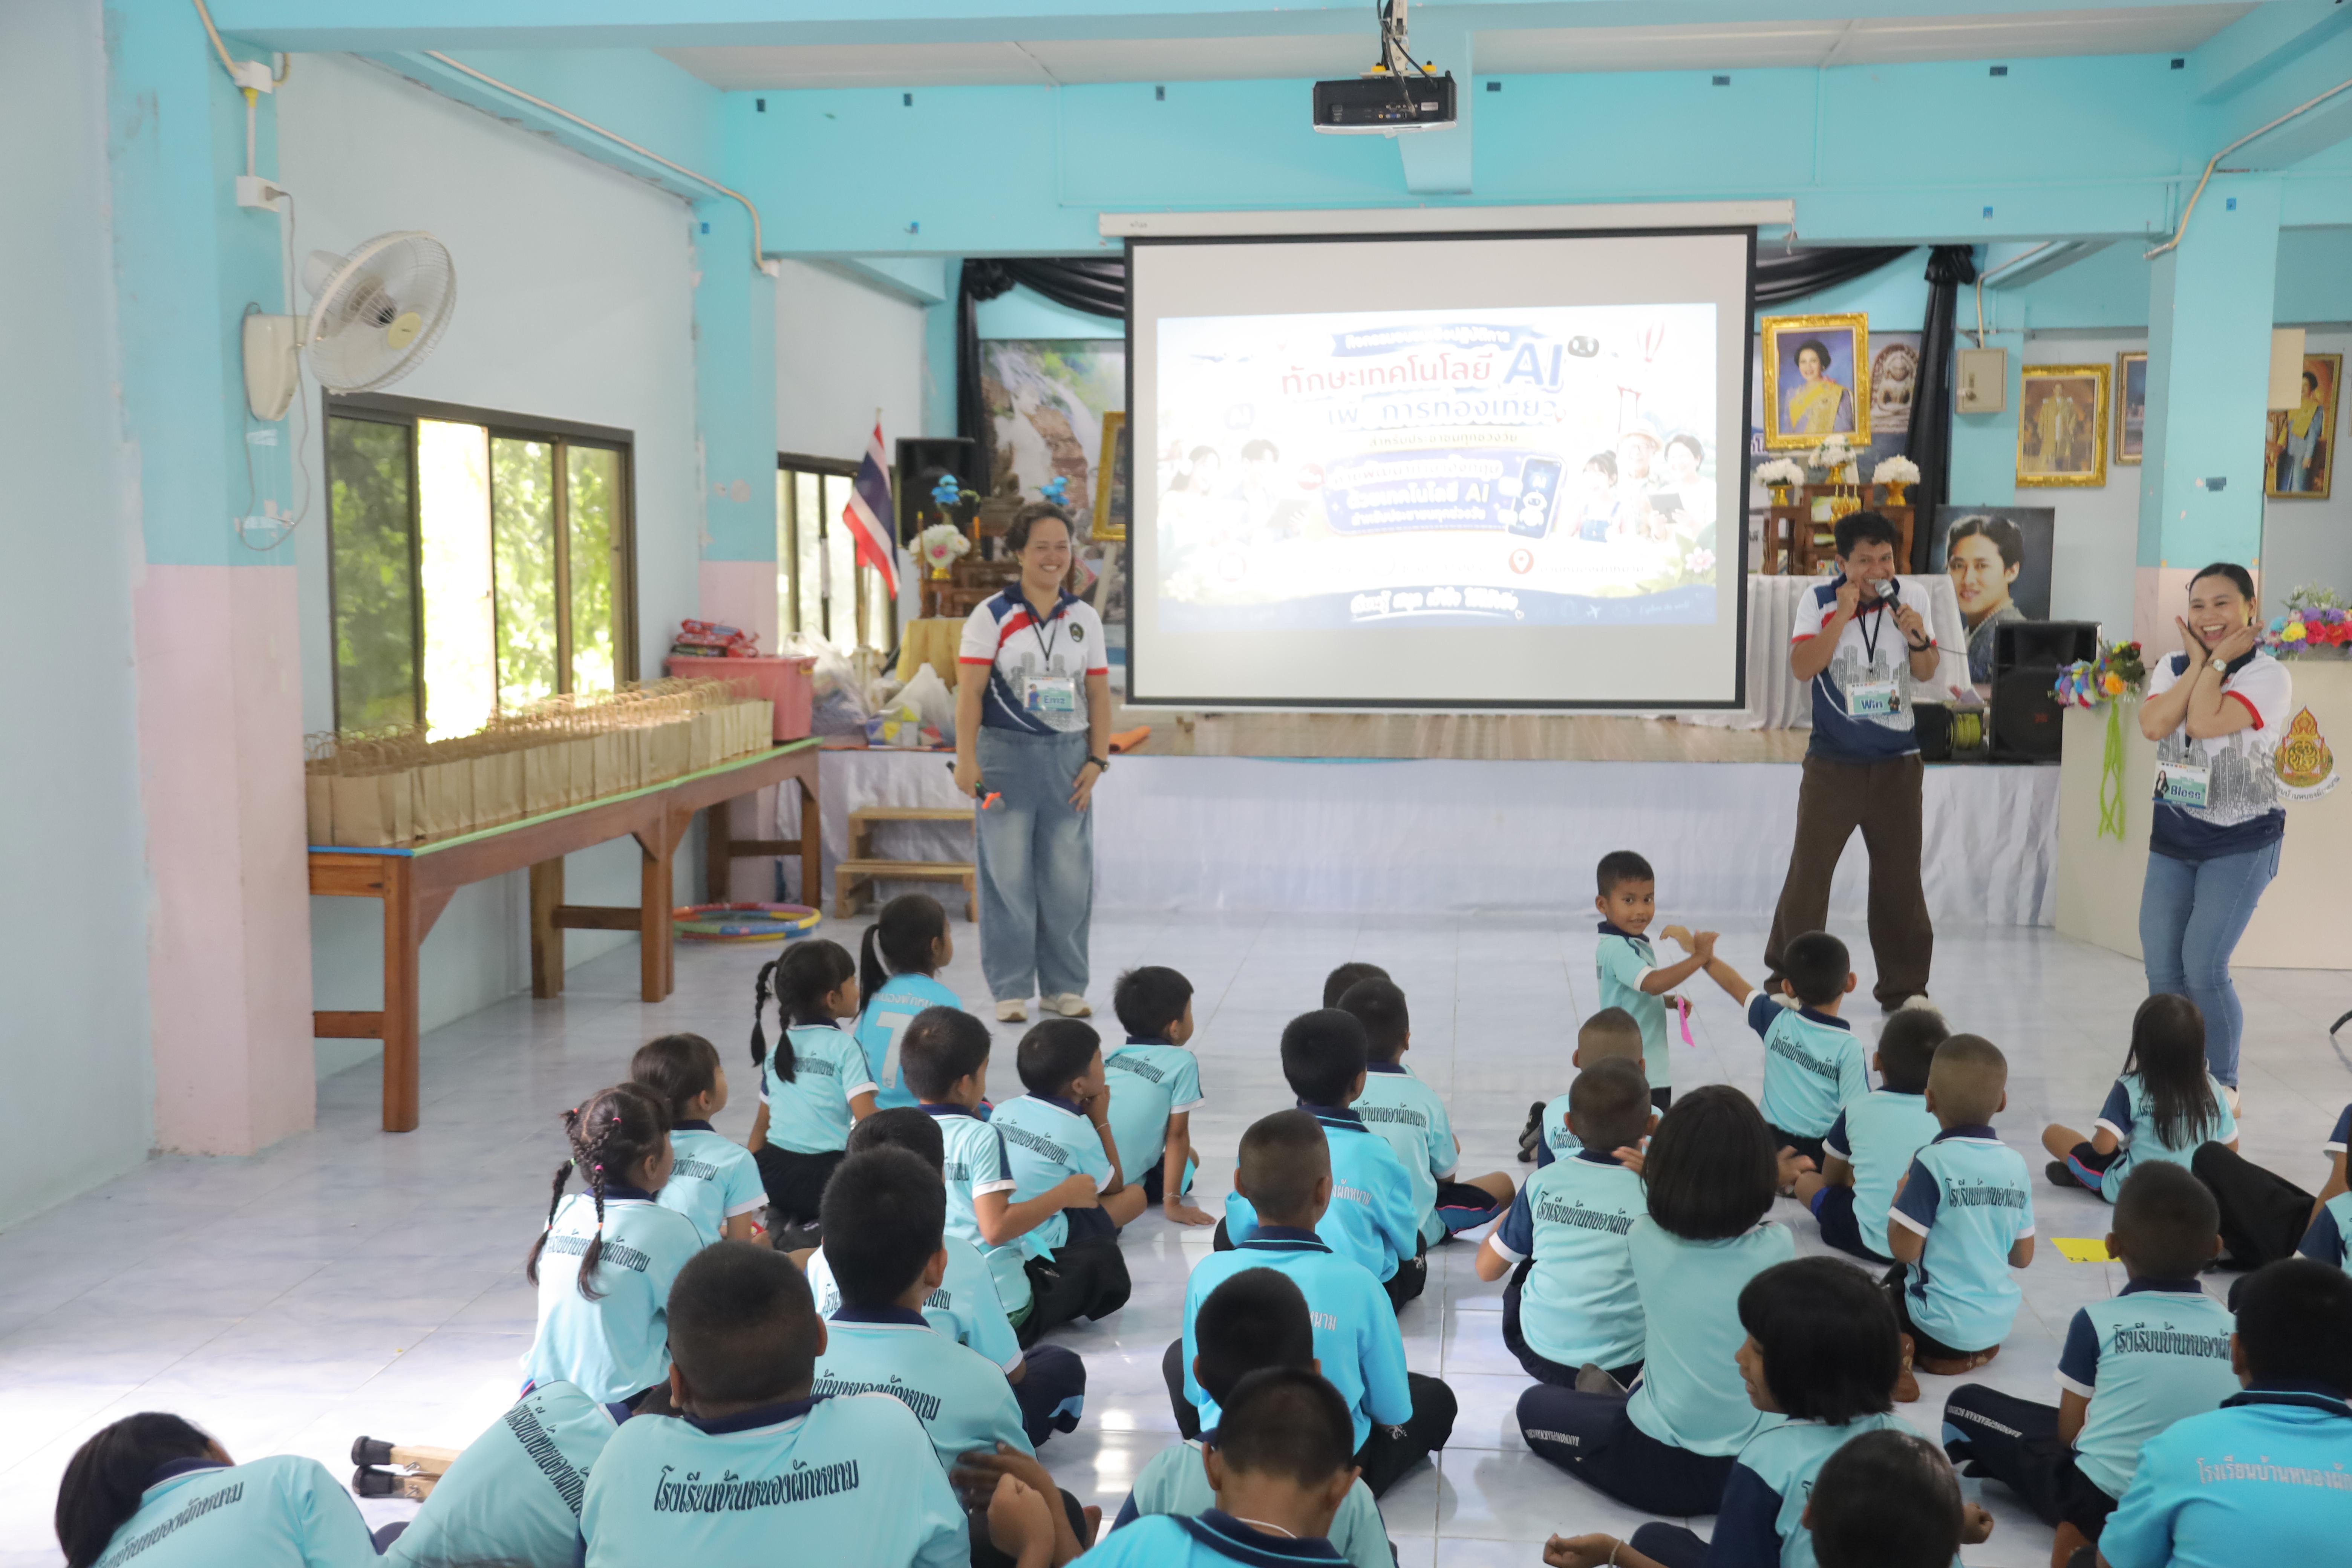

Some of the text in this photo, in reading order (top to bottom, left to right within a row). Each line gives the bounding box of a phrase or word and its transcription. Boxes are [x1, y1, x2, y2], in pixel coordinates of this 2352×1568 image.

[1282, 342, 1563, 395] ทักษะเทคโนโลยี AI
[1466, 486, 1490, 504] AI
[1861, 699, 1883, 709] Win
